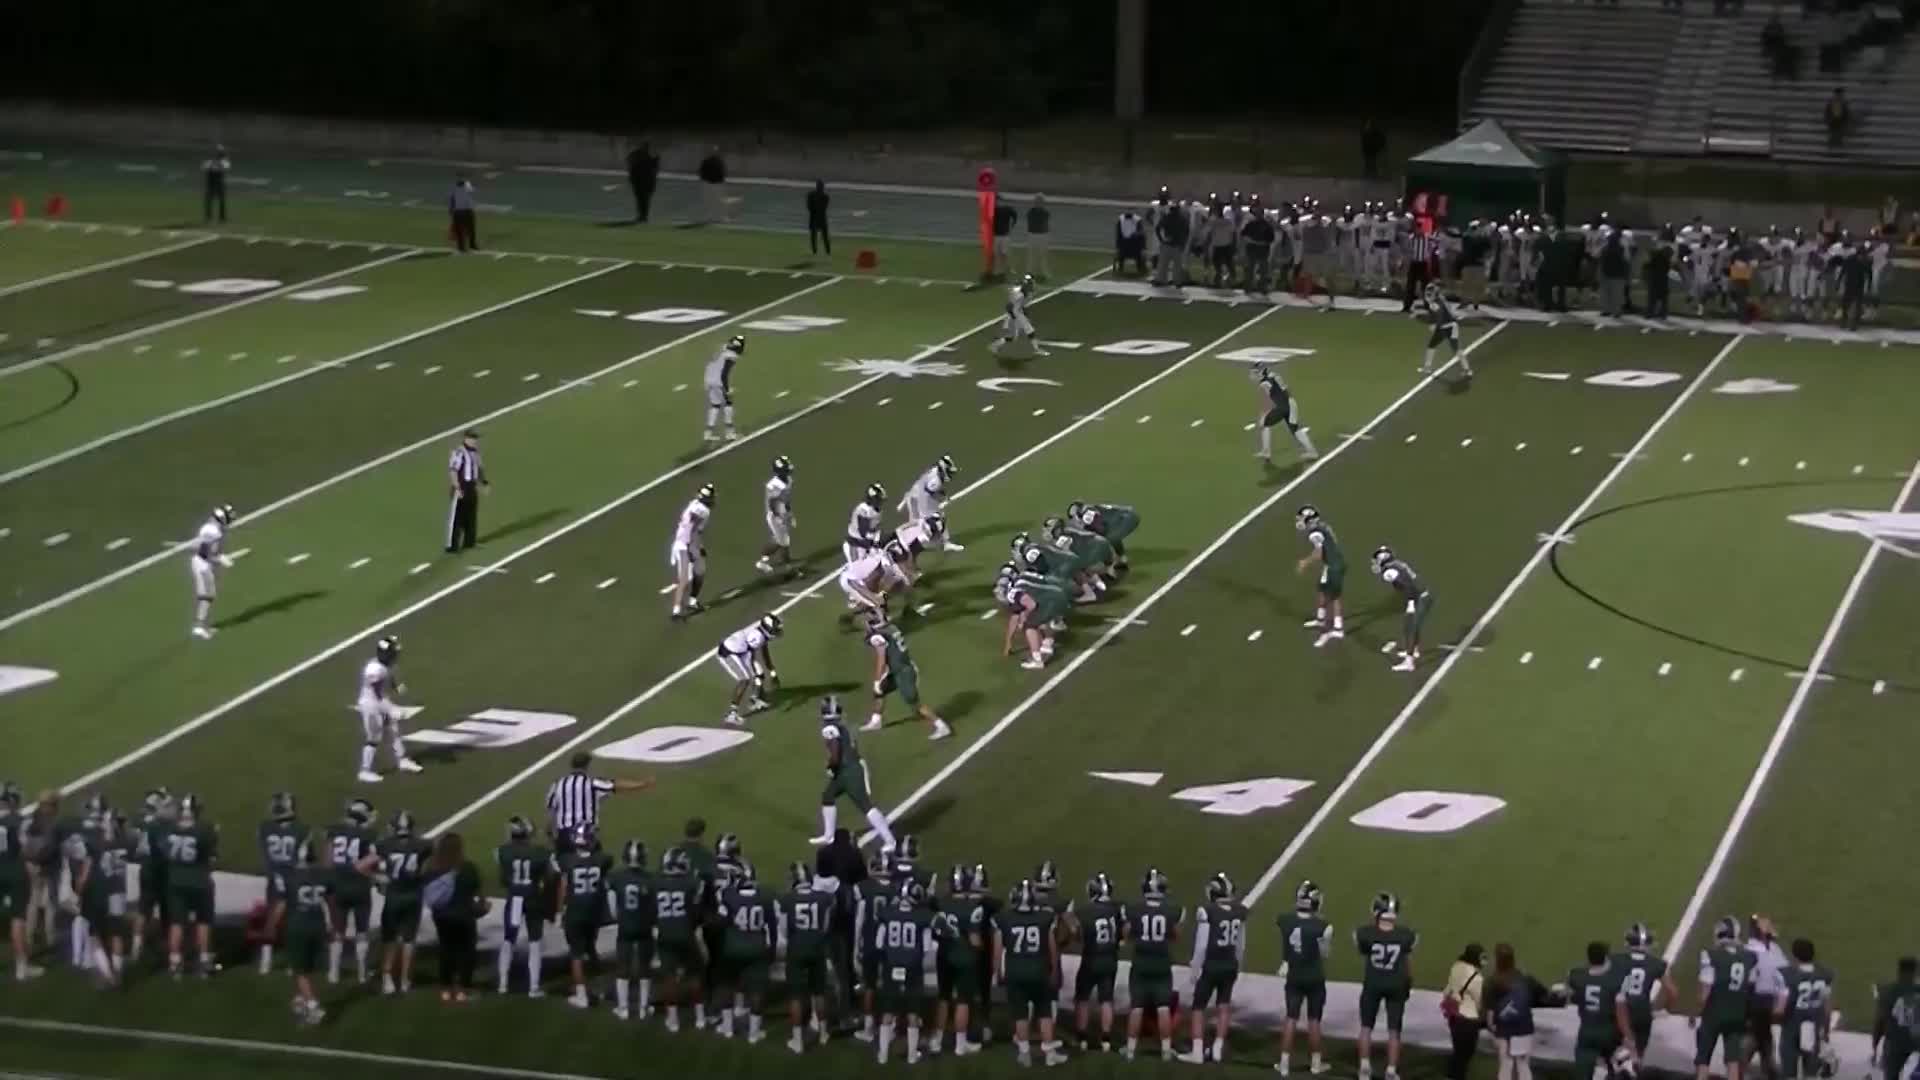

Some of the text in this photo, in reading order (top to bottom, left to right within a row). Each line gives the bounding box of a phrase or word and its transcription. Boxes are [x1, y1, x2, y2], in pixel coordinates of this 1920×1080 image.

[333, 835, 360, 864] 24
[389, 852, 418, 879] 74
[512, 859, 532, 885] 11
[572, 866, 601, 894] 52
[656, 891, 686, 919] 22
[734, 904, 765, 931] 40
[795, 902, 819, 930] 51
[888, 920, 917, 949] 80
[1011, 925, 1040, 953] 79
[1094, 917, 1117, 944] 61
[1140, 914, 1166, 942] 10
[1288, 927, 1303, 953] 4
[1371, 943, 1402, 970] 27
[1728, 961, 1745, 991] 9
[1584, 984, 1601, 1011] 5
